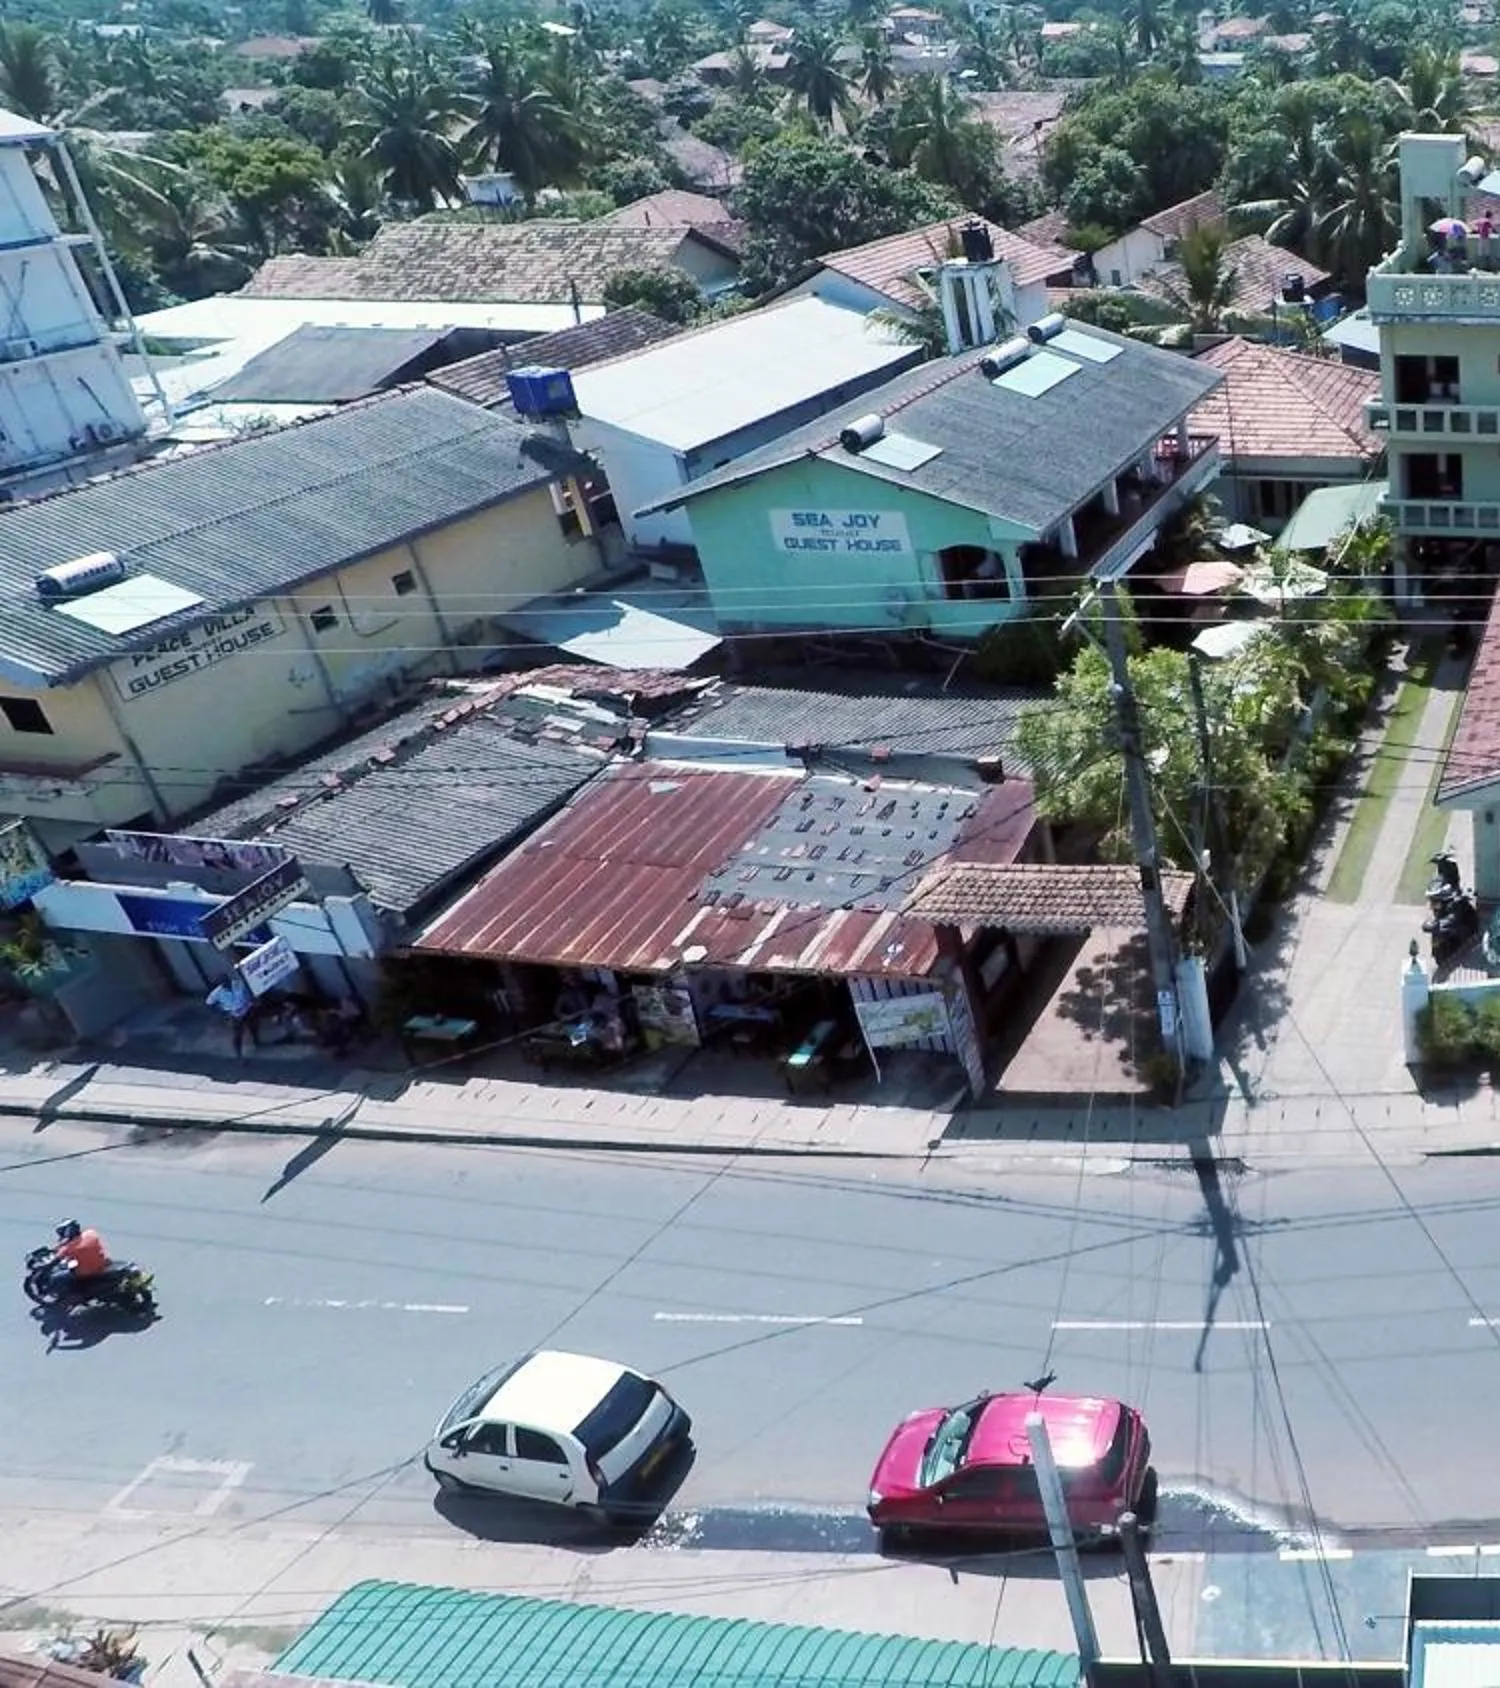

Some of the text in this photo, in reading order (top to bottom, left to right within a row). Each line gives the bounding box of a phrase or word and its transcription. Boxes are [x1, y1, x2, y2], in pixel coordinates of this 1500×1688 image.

[792, 512, 880, 528] SEA JOY
[784, 537, 902, 551] GUEST HOUSE
[131, 632, 192, 667] PEACE
[204, 607, 256, 637] VILLA
[129, 654, 200, 694] GUEST
[206, 622, 274, 660] HOUSE
